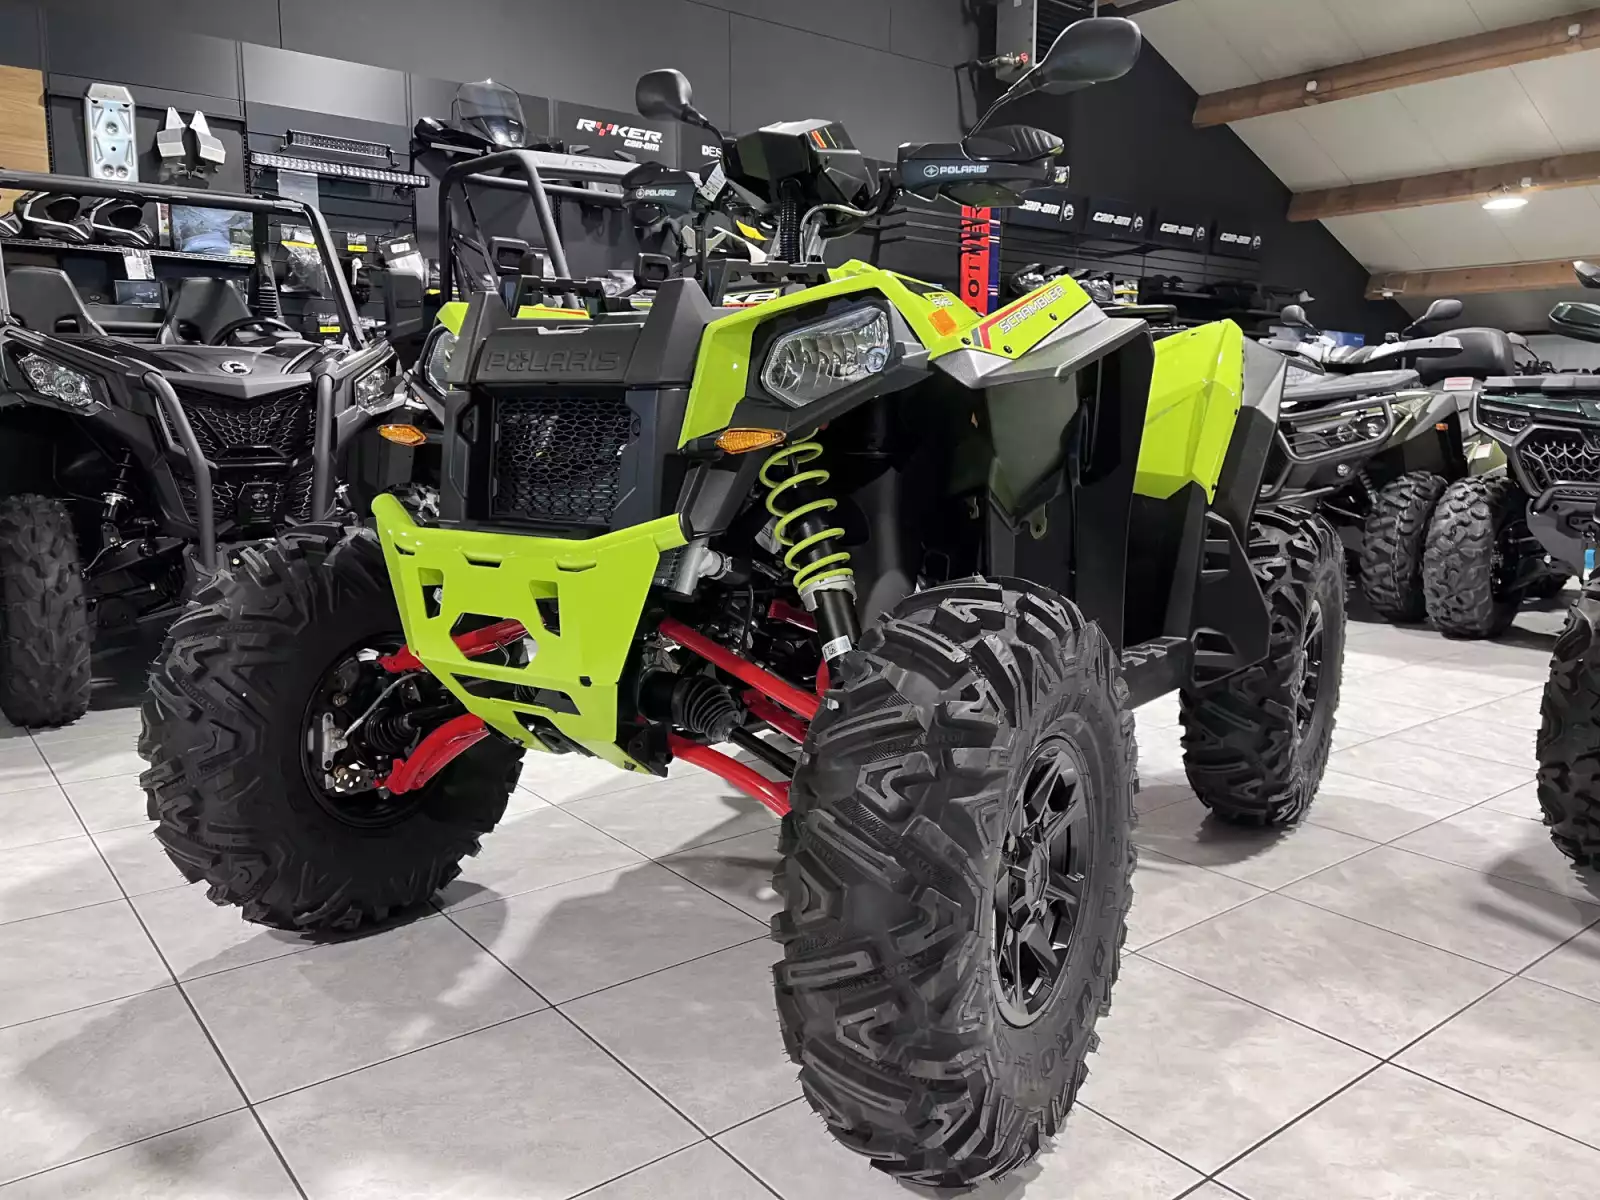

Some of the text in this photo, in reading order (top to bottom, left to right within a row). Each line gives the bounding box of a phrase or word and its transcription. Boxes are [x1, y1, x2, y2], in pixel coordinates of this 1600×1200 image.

[576, 118, 663, 143] RYKER
[939, 165, 989, 175] POLARIS
[644, 188, 677, 197] POLARIS
[1092, 211, 1132, 227] can-am
[998, 285, 1067, 335] SCRAMBLER
[484, 351, 618, 372] POLARIS
